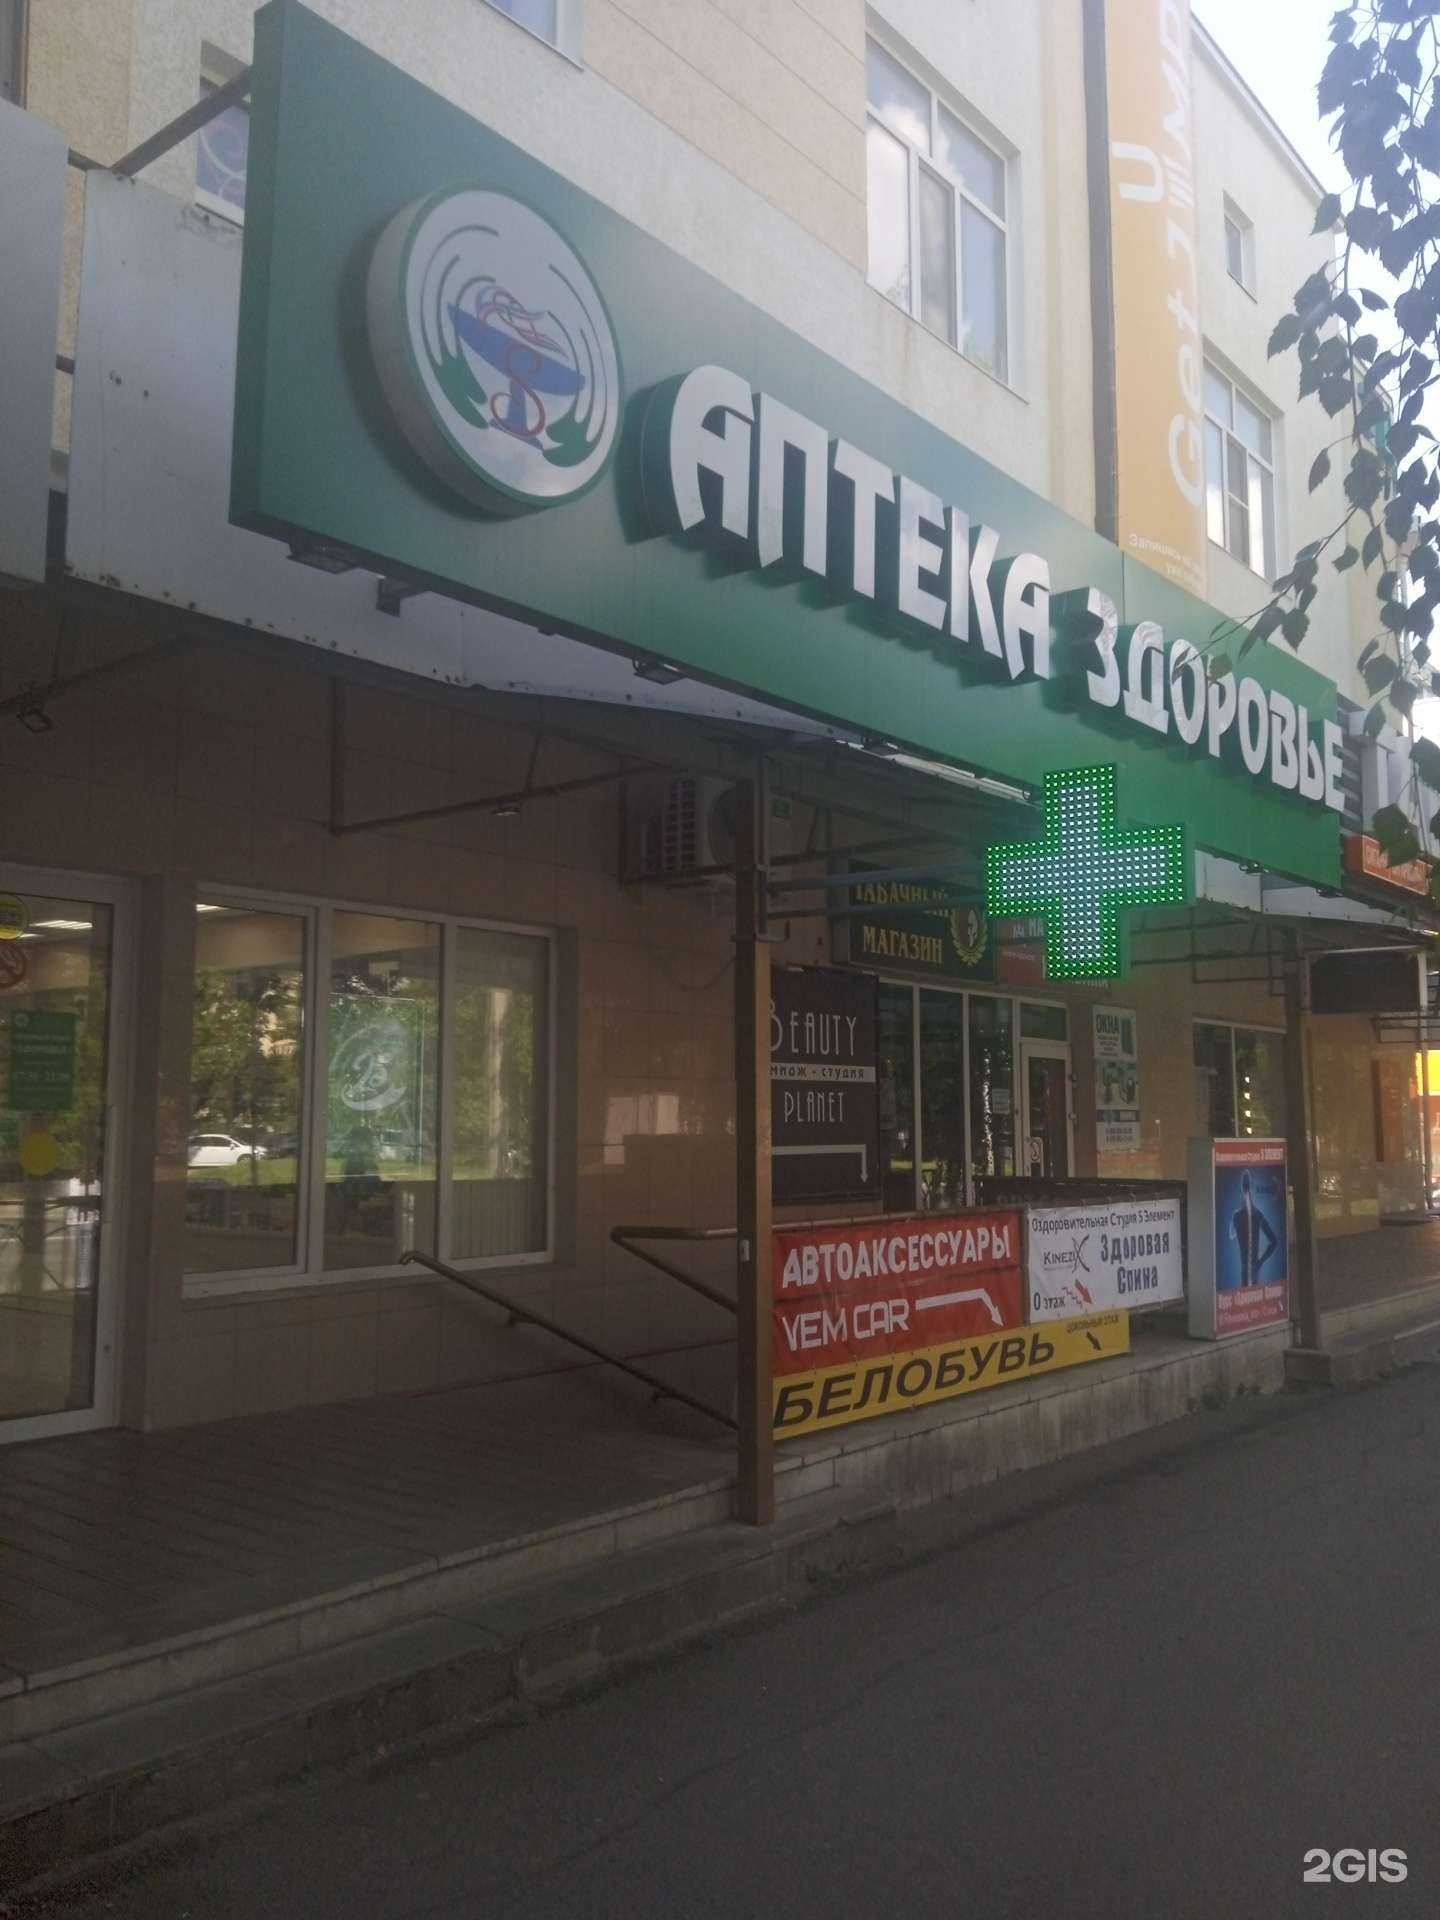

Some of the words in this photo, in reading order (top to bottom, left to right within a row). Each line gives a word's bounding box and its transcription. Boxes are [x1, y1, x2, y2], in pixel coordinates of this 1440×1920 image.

[669, 364, 1051, 681] АПТЕКА
[1087, 587, 1345, 812] ЗДОРОВЬЕ
[863, 925, 943, 964] МАГАЗИН
[1096, 1014, 1120, 1034] ОКНА
[784, 1091, 845, 1123] PLANET
[1031, 1215, 1109, 1235] Оздоровительная
[1110, 1212, 1137, 1229] Студия
[1138, 1211, 1143, 1223] 5
[782, 1225, 1011, 1288] АВТОАКСЕССУАРЫ
[1100, 1231, 1170, 1265] Здоровая
[1117, 1265, 1158, 1294] Спина
[772, 1332, 1055, 1428] БЕЛОБУВЬ
